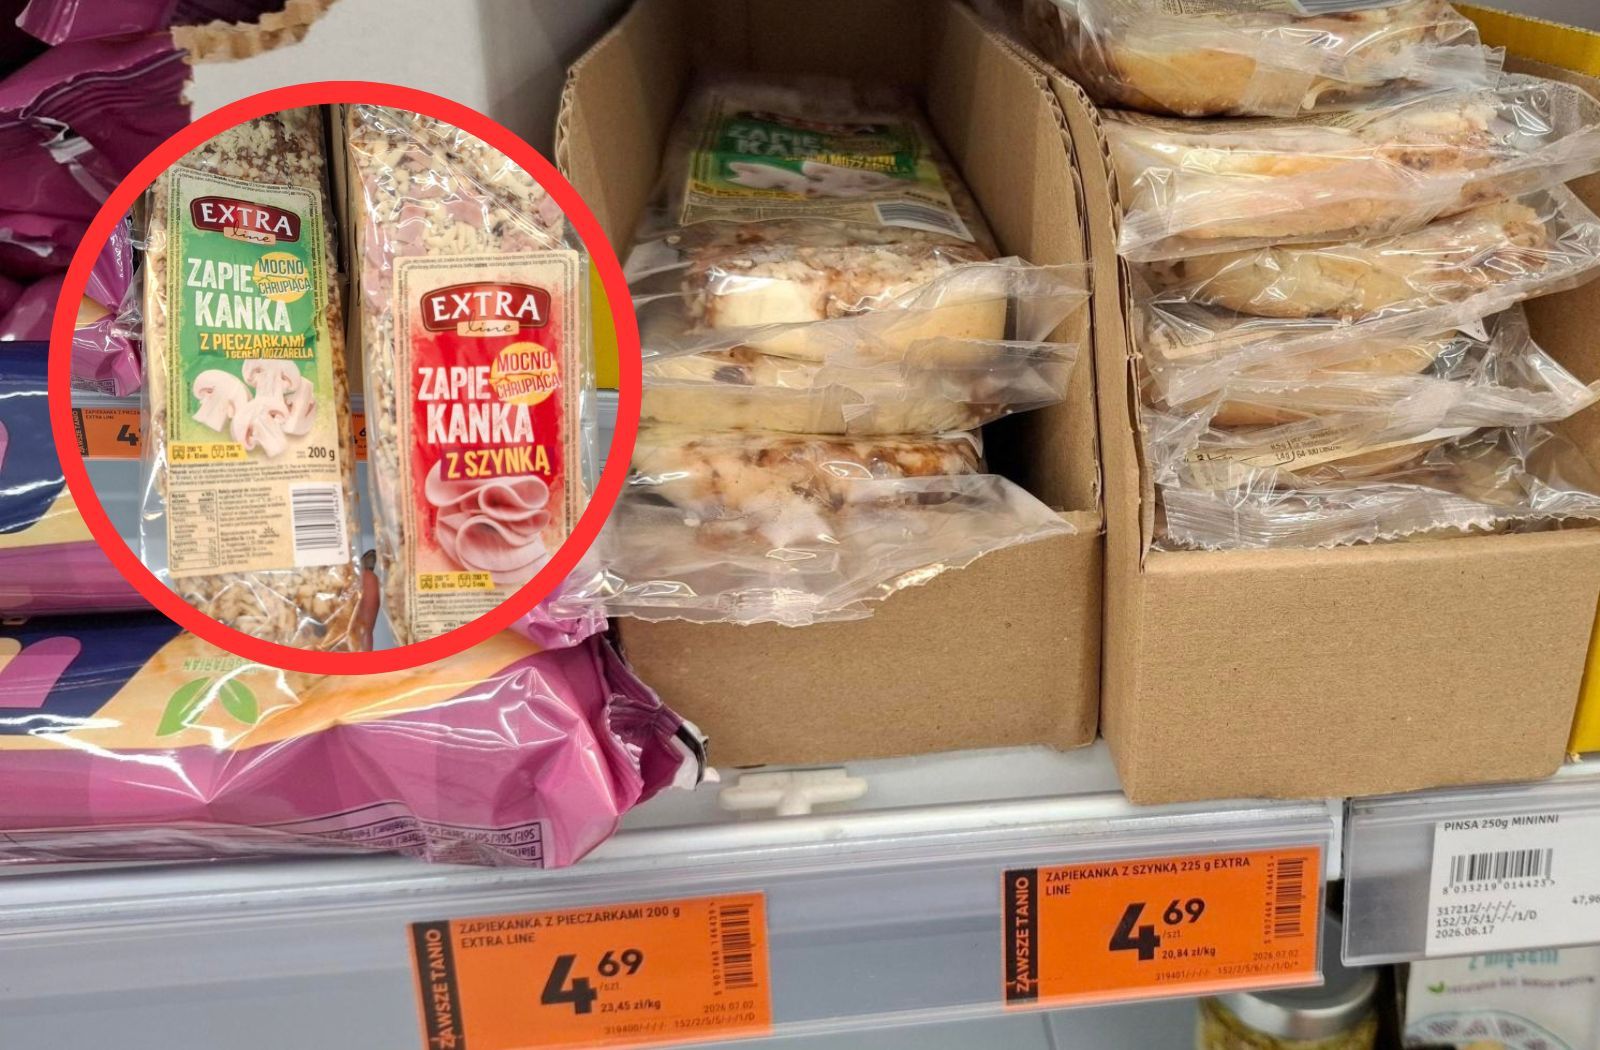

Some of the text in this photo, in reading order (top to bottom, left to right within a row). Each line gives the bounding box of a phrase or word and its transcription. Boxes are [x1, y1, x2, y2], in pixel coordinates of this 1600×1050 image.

[200, 202, 293, 236] EXTRA
[233, 221, 271, 243] line
[187, 257, 254, 293] ZAPIE
[258, 258, 305, 275] MOCNO
[258, 277, 312, 295] CHRUPIĄCA
[194, 291, 293, 333] KANKA
[431, 291, 541, 322] EXTRA
[466, 310, 514, 334] line
[200, 333, 305, 352] Z PIECZARKAMI
[497, 351, 553, 373] MOCNO
[417, 365, 492, 401] ZAPIE
[496, 374, 561, 398] CHRUPIĄCA
[116, 424, 139, 446] 4
[426, 402, 535, 444] KANKA
[308, 446, 326, 459] 200
[328, 449, 336, 461] g
[446, 444, 552, 479] Z SZYNKĄ
[1444, 814, 1560, 832] PINSA 250g MININNI
[1045, 857, 1250, 882] ZAPIEKANKA Z SZYNKĄ 225 g EXTRA
[1045, 884, 1071, 896] LINE
[1454, 882, 1497, 894] 033219
[460, 906, 681, 935] ZAPIEKANKA Z PIECZARKAMI 200 g
[1162, 897, 1206, 926] 69
[461, 932, 536, 949] EXTRA LINE
[1016, 876, 1030, 993] ZAWSZE TANIO
[1108, 902, 1161, 961] 4
[1434, 925, 1496, 939] 2026.06.17
[597, 948, 644, 978] 69
[1162, 947, 1216, 960] 20,84 zł/kg
[425, 929, 456, 1049] ZAWSZE TANIO
[540, 953, 598, 1015] 4
[601, 999, 662, 1013] 23,45 zł/kg
